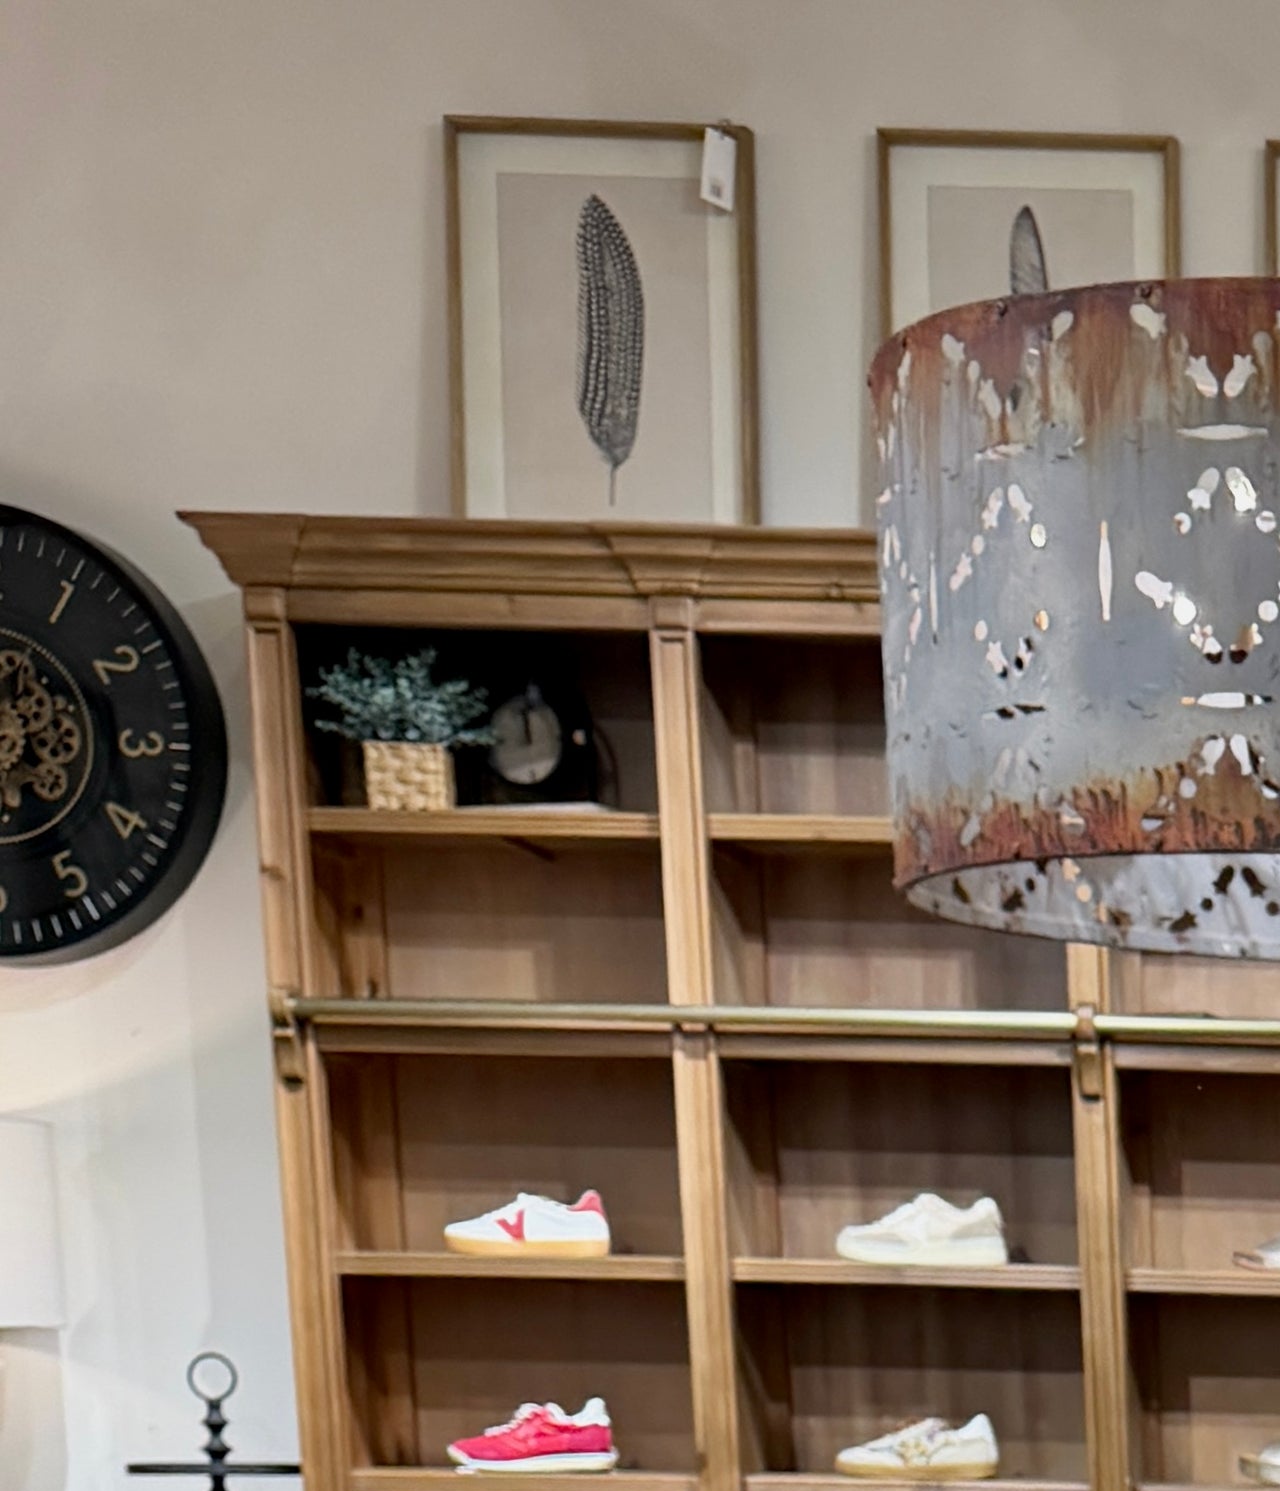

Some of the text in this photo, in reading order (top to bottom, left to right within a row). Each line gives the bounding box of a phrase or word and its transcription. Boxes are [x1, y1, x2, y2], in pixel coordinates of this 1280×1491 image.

[50, 580, 75, 624] 1
[92, 644, 140, 685] 2
[118, 728, 165, 758] 3
[104, 801, 147, 839] 4
[52, 849, 88, 898] 5
